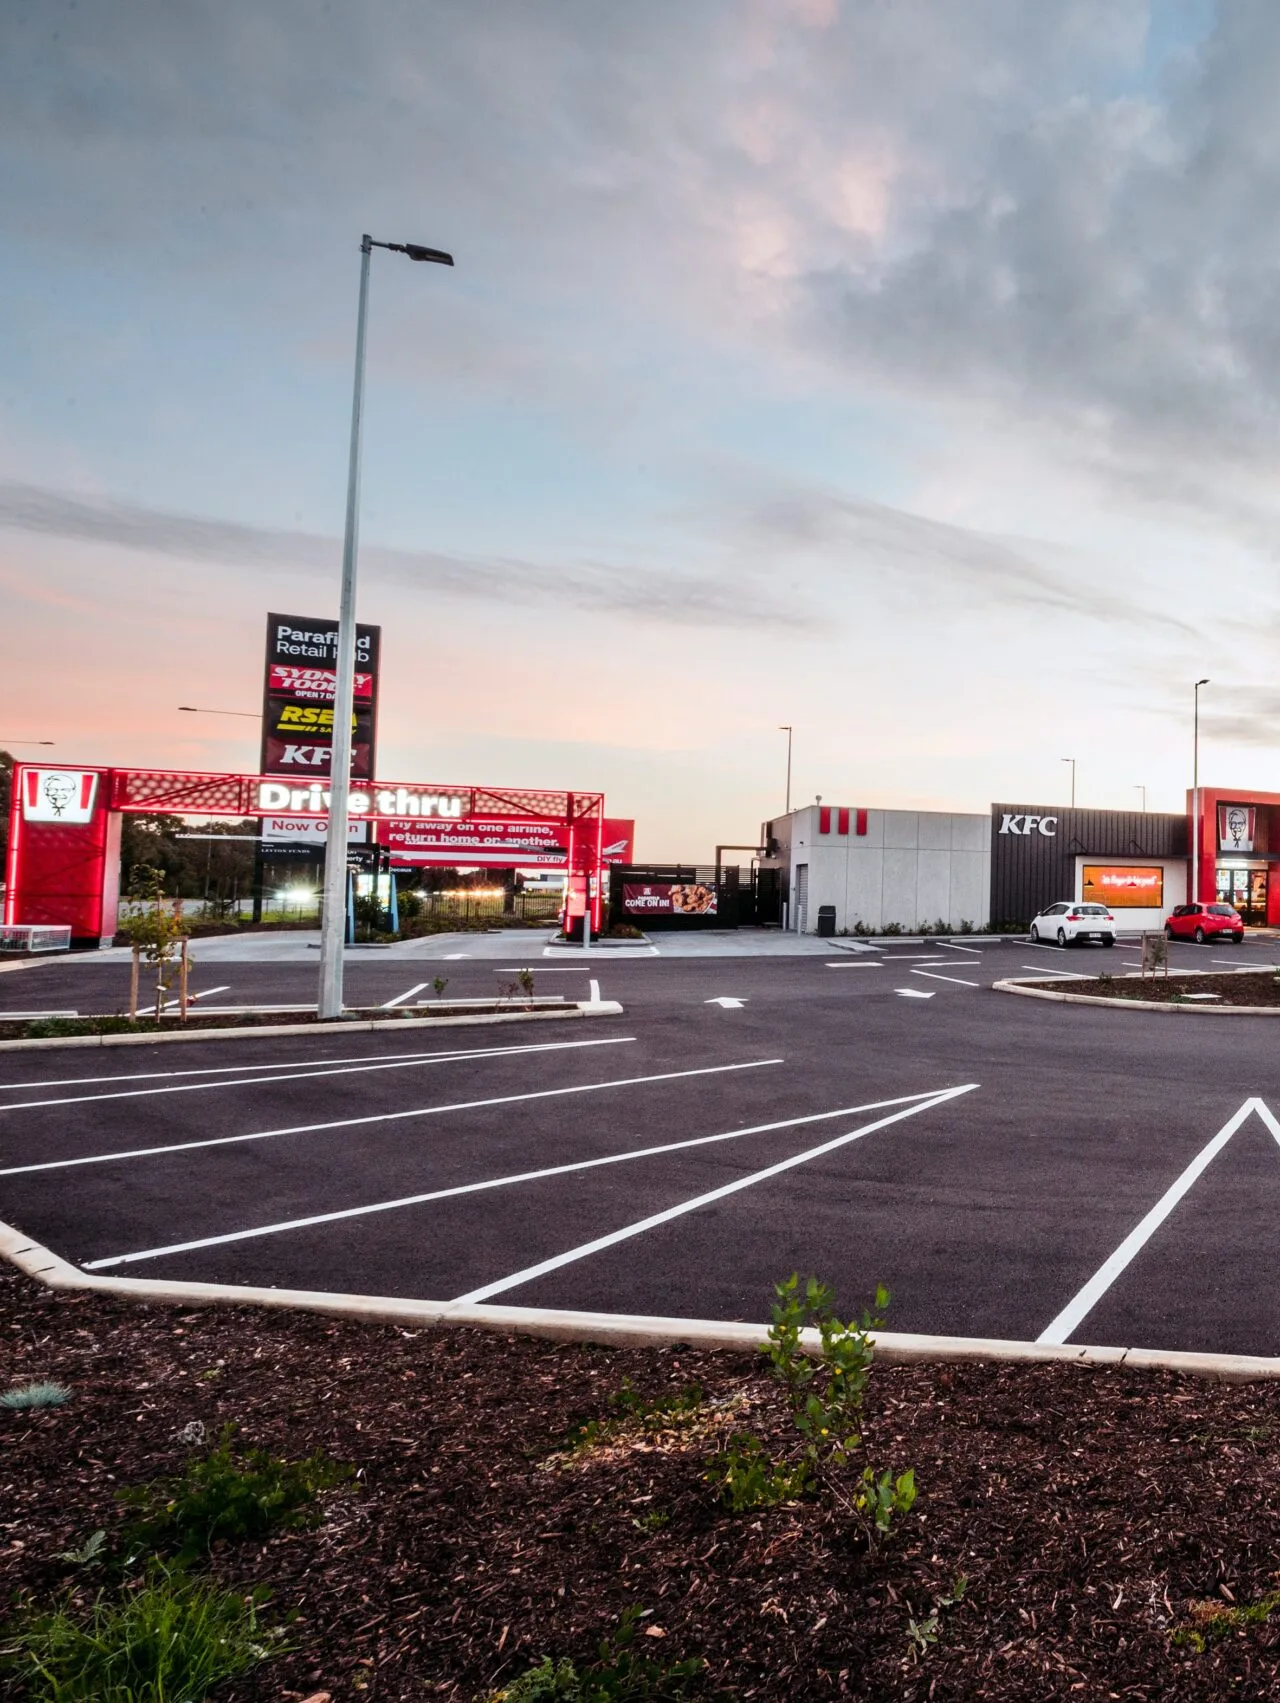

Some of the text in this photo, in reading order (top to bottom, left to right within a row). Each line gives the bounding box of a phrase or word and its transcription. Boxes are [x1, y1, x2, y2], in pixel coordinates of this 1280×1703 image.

[277, 626, 370, 649] Parafid
[276, 641, 327, 658] Retail
[272, 667, 372, 685] SYDNY
[295, 690, 320, 699] OPEN
[376, 788, 461, 818] thru
[272, 820, 358, 833] Now On
[415, 823, 453, 831] away
[456, 823, 475, 831] on
[478, 824, 504, 832] one
[998, 814, 1058, 837] KFC
[389, 833, 436, 843] return
[440, 834, 480, 845] home
[504, 836, 560, 847] another.
[625, 899, 670, 907] COME ON IN!
